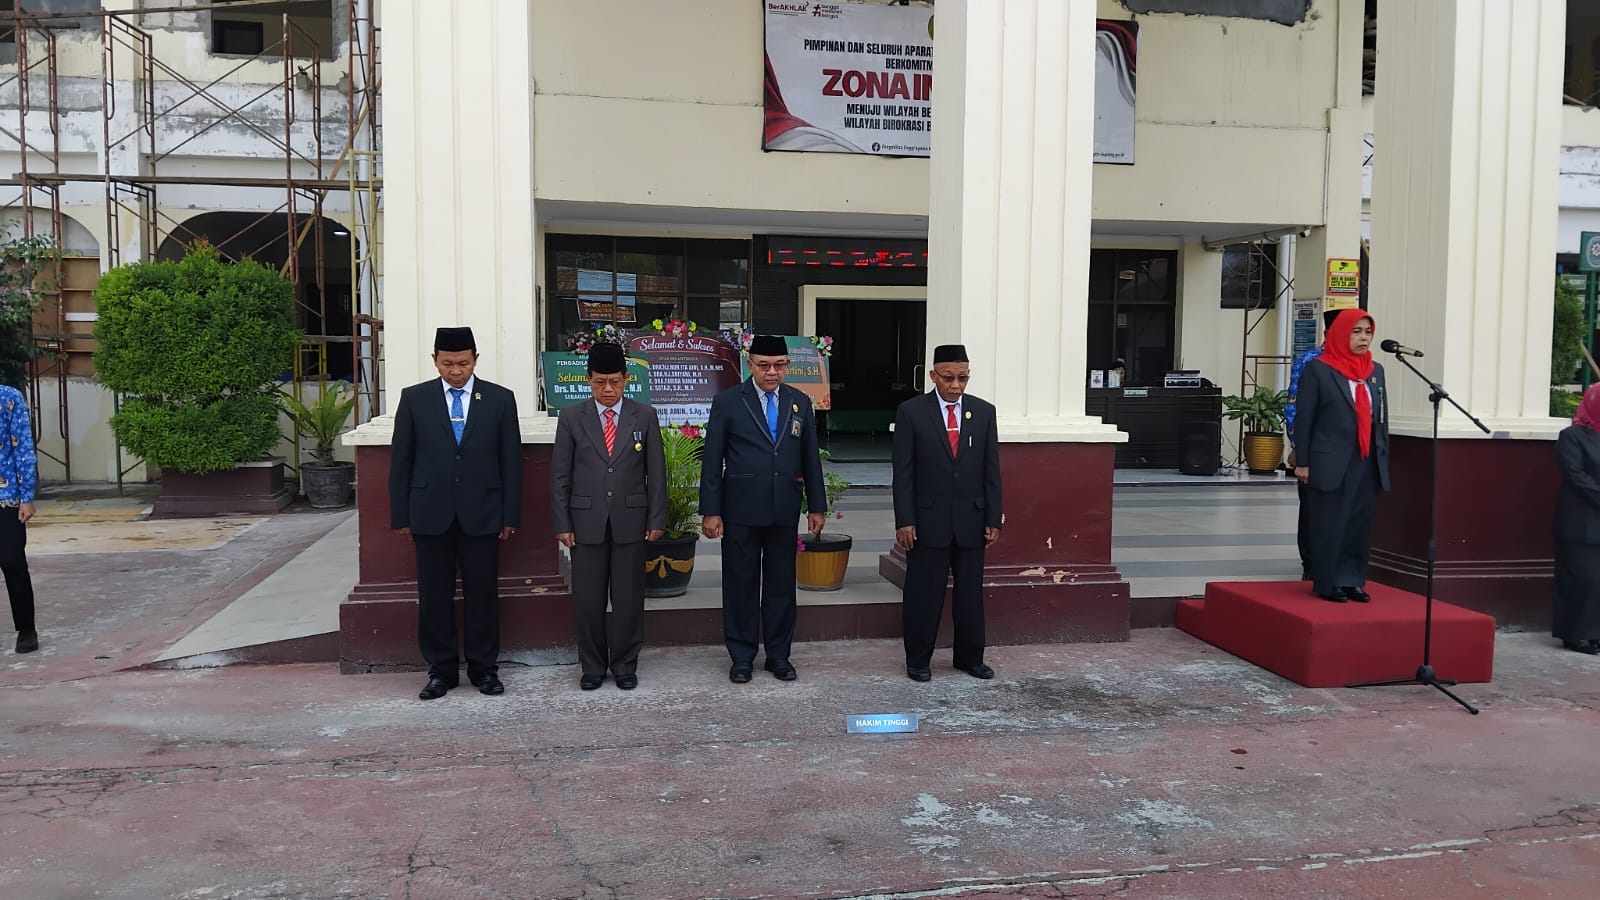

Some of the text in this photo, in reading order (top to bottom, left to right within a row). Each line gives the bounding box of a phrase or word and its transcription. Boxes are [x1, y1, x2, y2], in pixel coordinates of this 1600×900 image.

[768, 2, 809, 12] BerAKHLAK
[804, 39, 846, 53] PIMPINAN
[847, 41, 865, 54] DAN
[866, 43, 902, 56] SELURUH
[822, 68, 910, 100] ZONA
[846, 103, 881, 116] MENUJU
[883, 104, 919, 117] WILAYAH
[844, 117, 880, 129] WILAYAH
[883, 119, 924, 132] BIROKRASI
[640, 338, 714, 352] Selamat & Sukses
[554, 384, 569, 393] Drs.
[856, 719, 909, 727] HAKIM TINGGI
